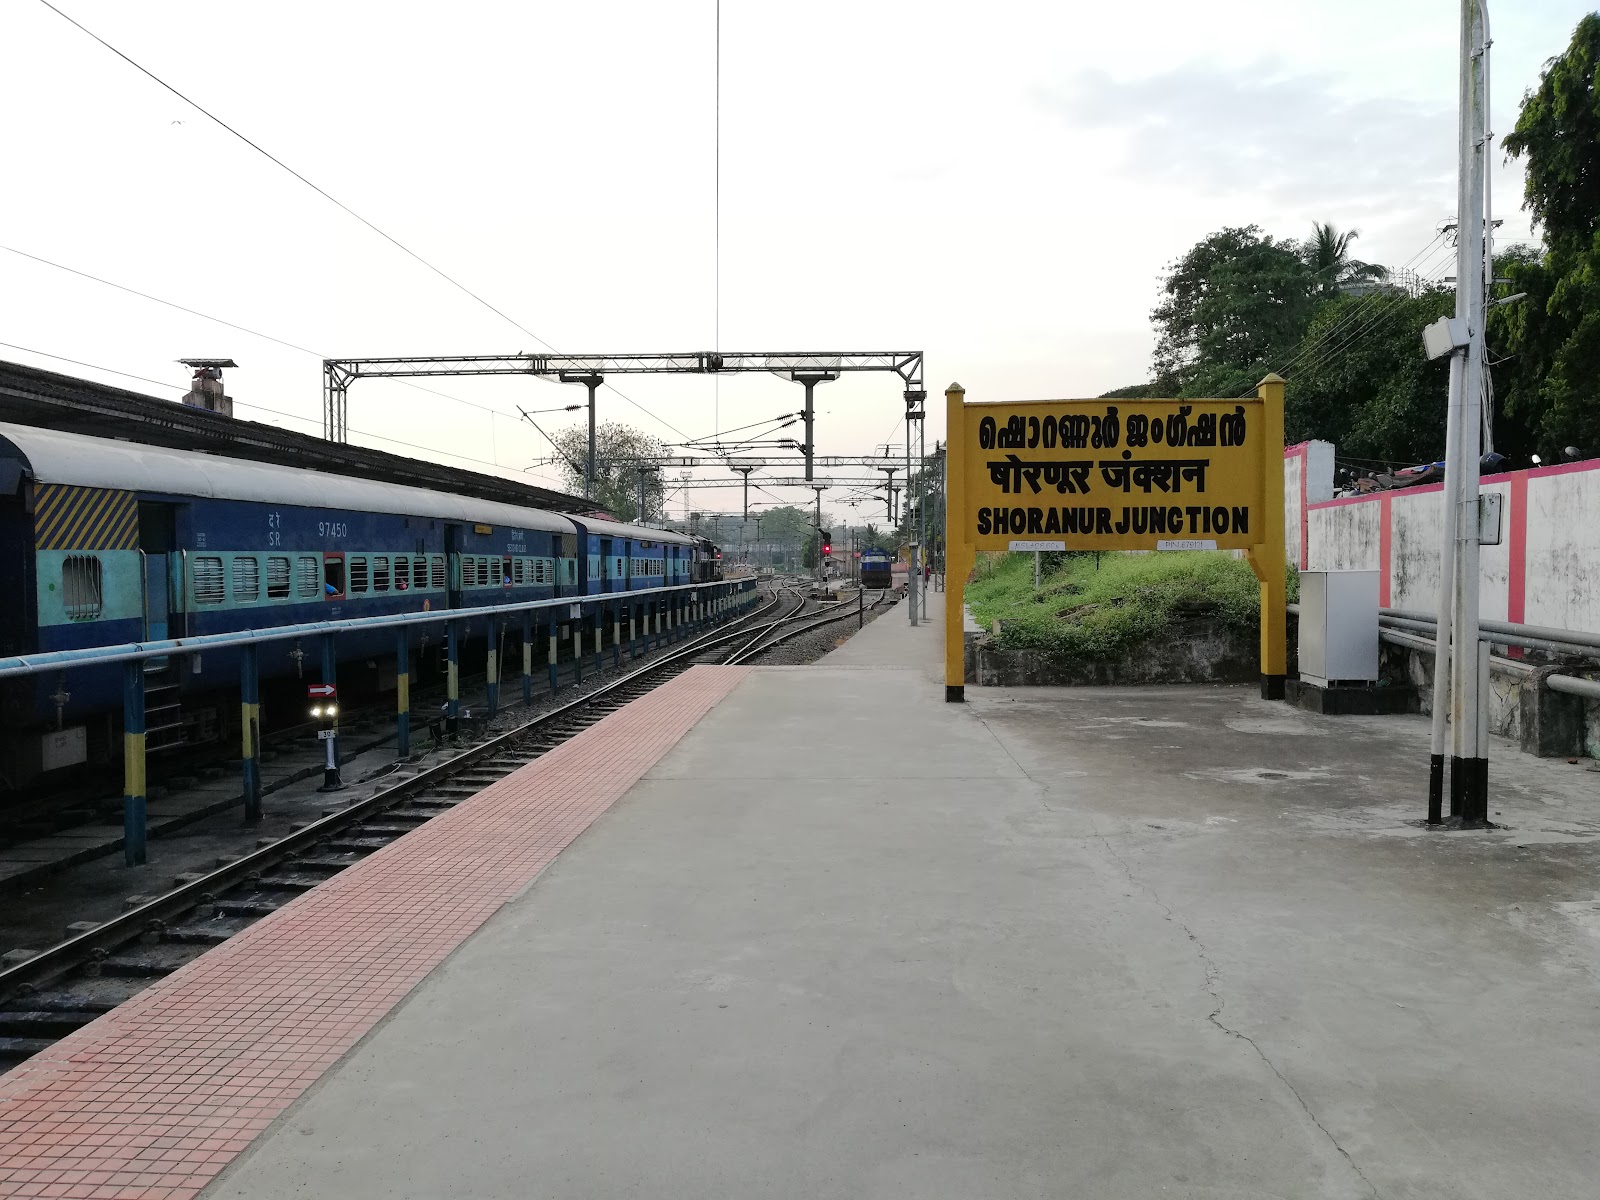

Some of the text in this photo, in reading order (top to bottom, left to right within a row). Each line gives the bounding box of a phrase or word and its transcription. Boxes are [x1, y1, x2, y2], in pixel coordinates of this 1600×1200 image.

[1126, 406, 1246, 448] ജംഗ്ഷൻ
[987, 450, 1210, 494] षोरणूर जंक्शन
[318, 522, 347, 537] 97450
[977, 506, 1249, 535] SHORANUR JUNCTION
[269, 531, 281, 546] SR
